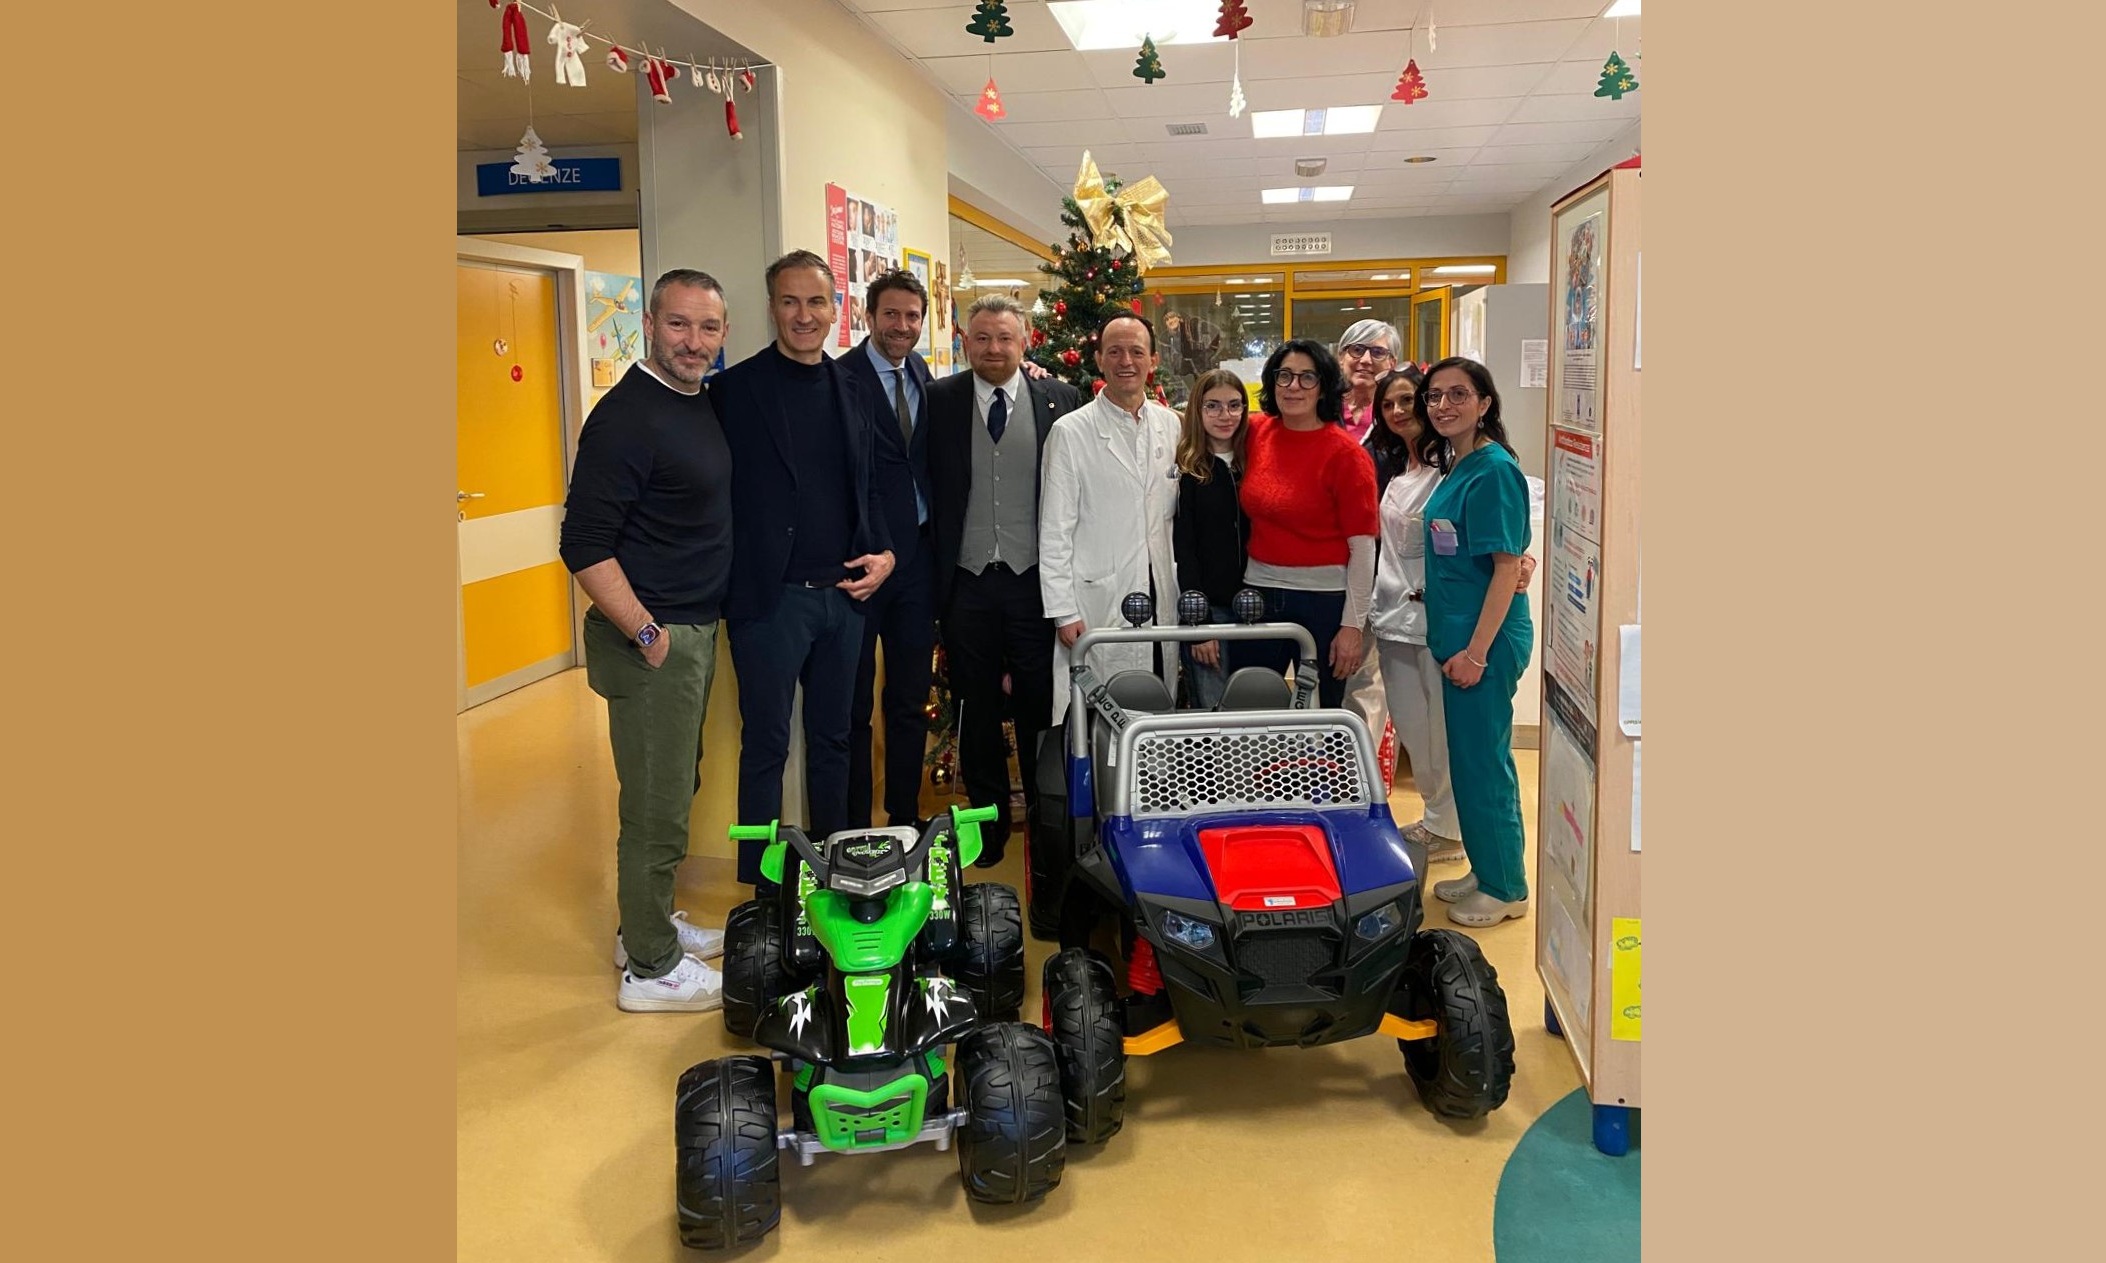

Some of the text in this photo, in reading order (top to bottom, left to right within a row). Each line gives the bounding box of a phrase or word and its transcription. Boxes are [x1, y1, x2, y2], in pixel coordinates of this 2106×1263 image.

[508, 168, 581, 186] DEENZE
[929, 909, 951, 920] 330W
[1242, 910, 1328, 927] POLARIS
[796, 926, 813, 936] 330
